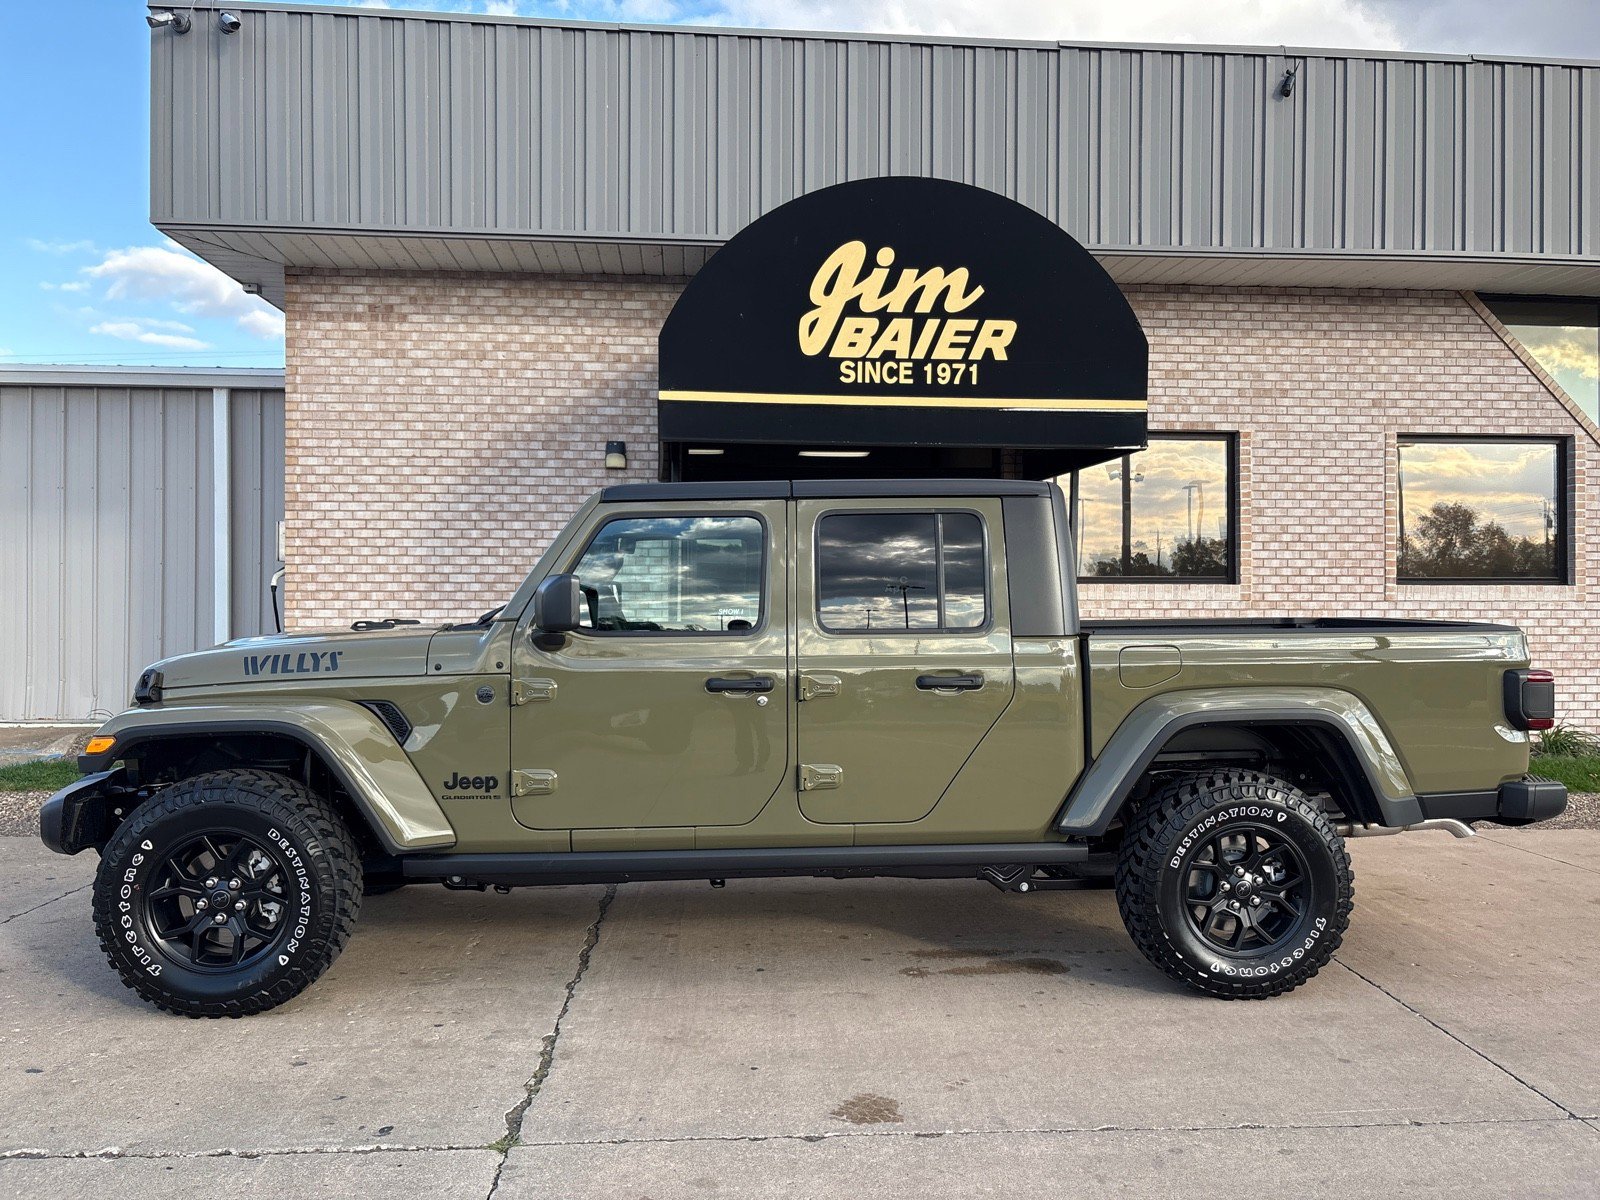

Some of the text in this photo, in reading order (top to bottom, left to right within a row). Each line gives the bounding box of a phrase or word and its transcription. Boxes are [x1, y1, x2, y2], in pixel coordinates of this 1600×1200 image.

[798, 240, 985, 356] Jim
[828, 317, 1018, 361] BAIER
[839, 360, 978, 385] SINCE 1971
[243, 651, 343, 675] WILLYS
[443, 772, 499, 793] Jeep
[1170, 806, 1274, 869] DESTINATION
[267, 828, 311, 954] DESTINATION
